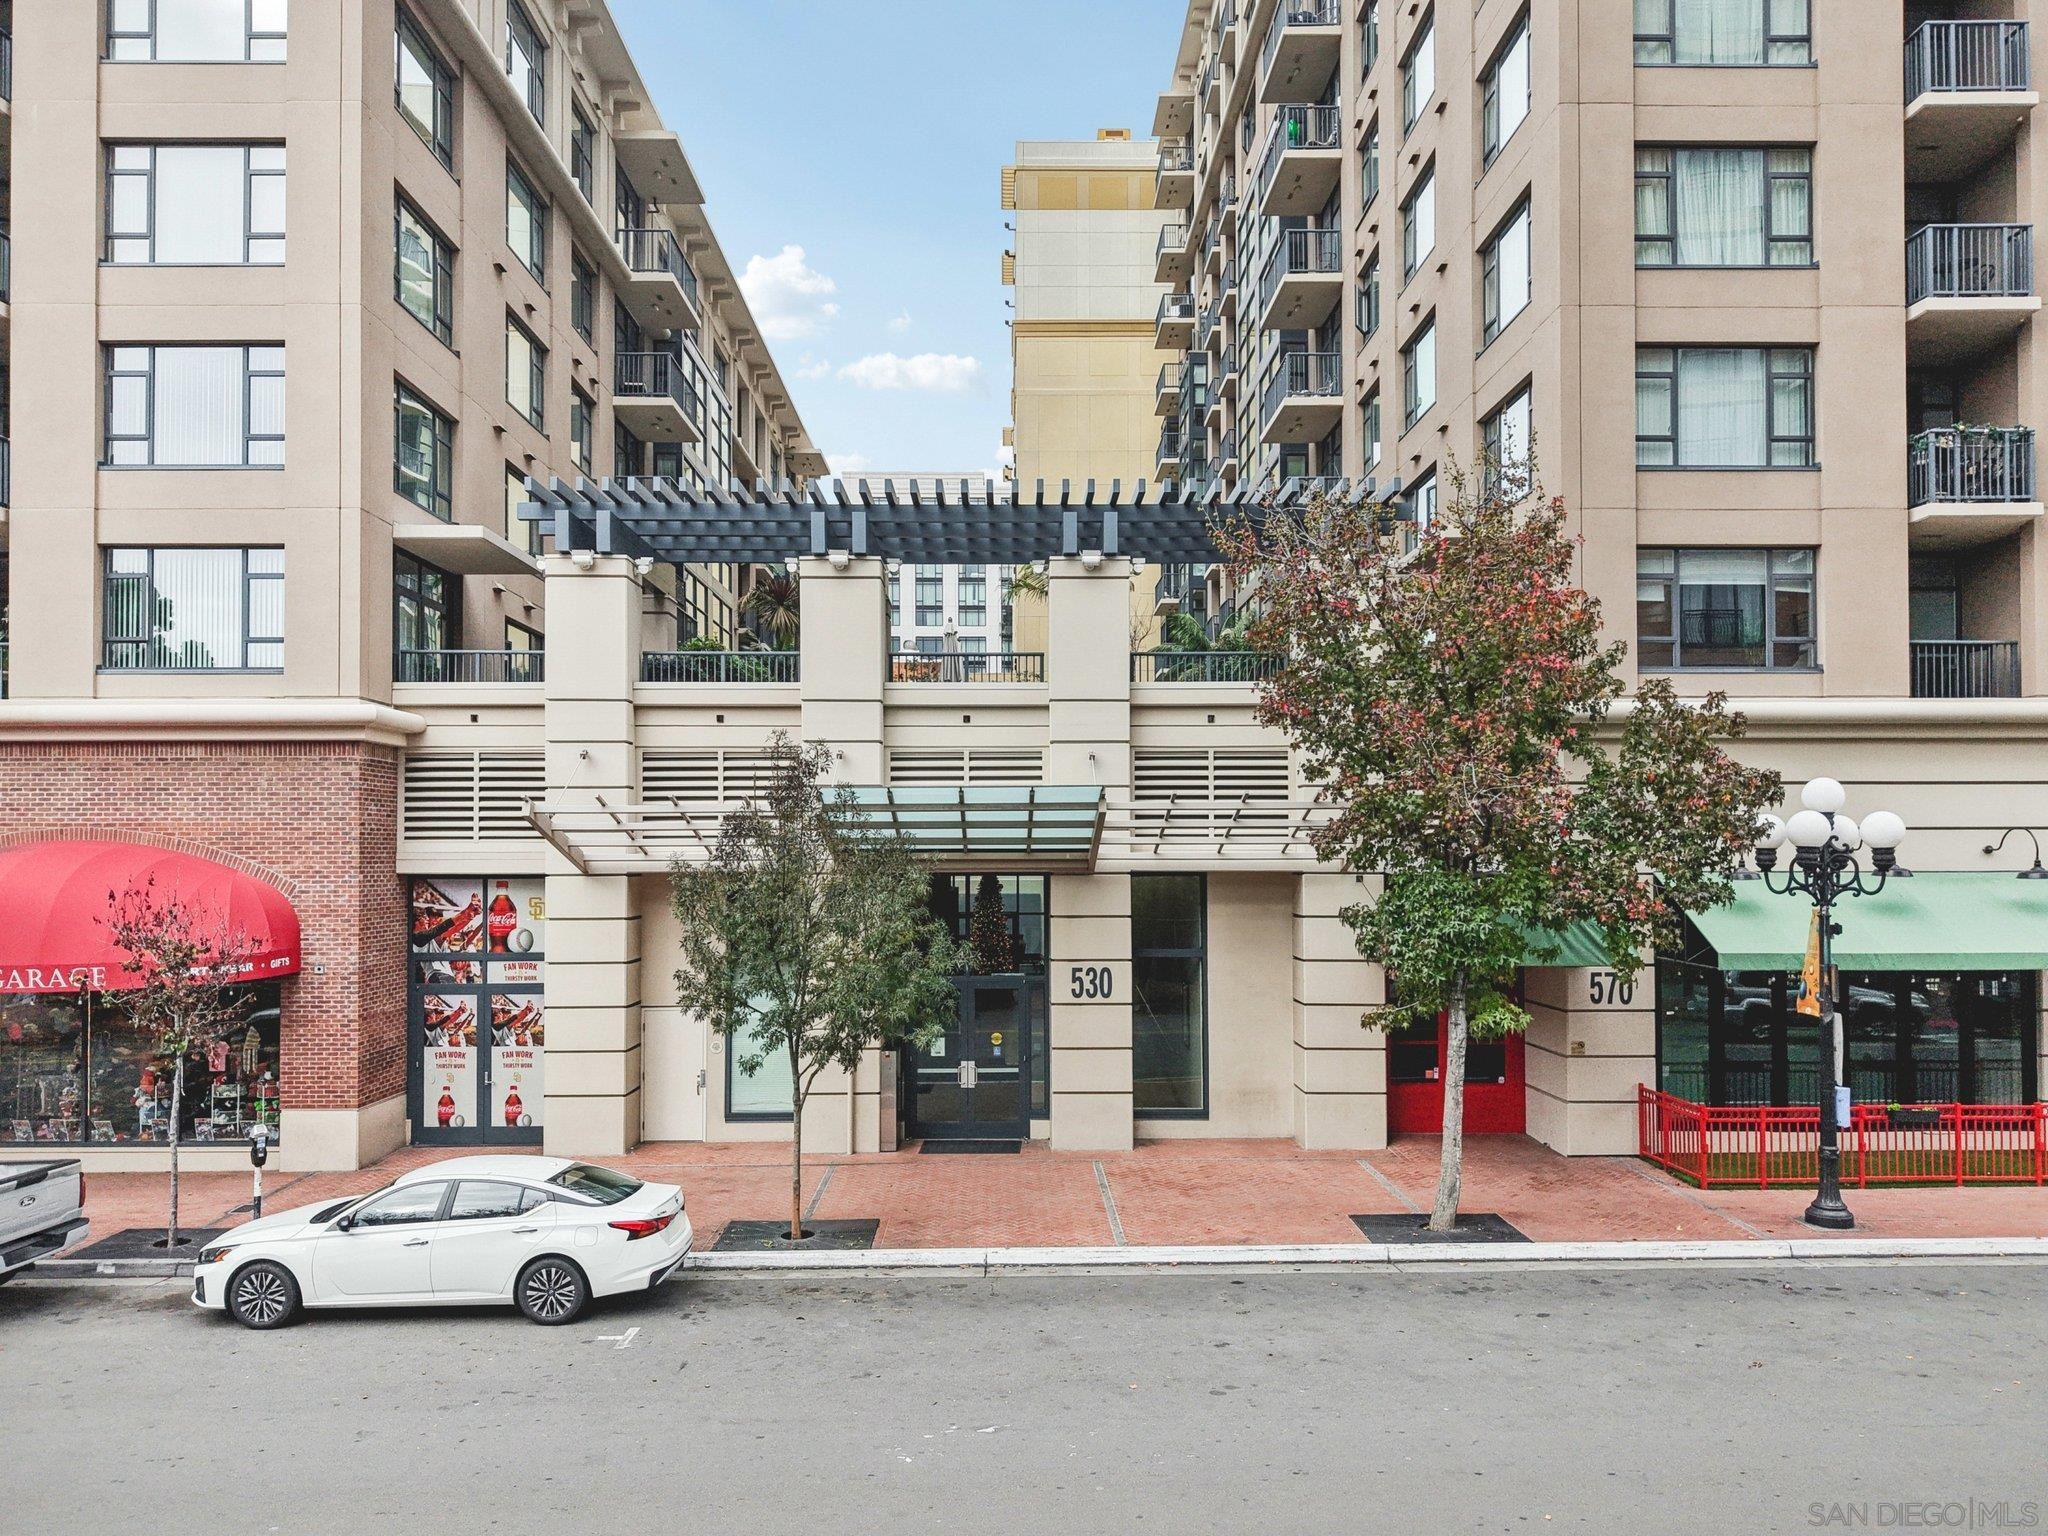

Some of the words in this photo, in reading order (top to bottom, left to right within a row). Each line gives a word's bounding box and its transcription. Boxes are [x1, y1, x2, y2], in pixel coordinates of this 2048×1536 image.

[270, 957, 290, 968] GIFTS
[503, 962, 517, 971] FAN
[518, 962, 538, 971] WORK
[1071, 967, 1113, 999] 530
[1590, 972, 1633, 1005] 570
[434, 1051, 447, 1060] FAN
[448, 1051, 467, 1060] WORK
[502, 1050, 514, 1059] FAN
[515, 1050, 534, 1059] WORK
